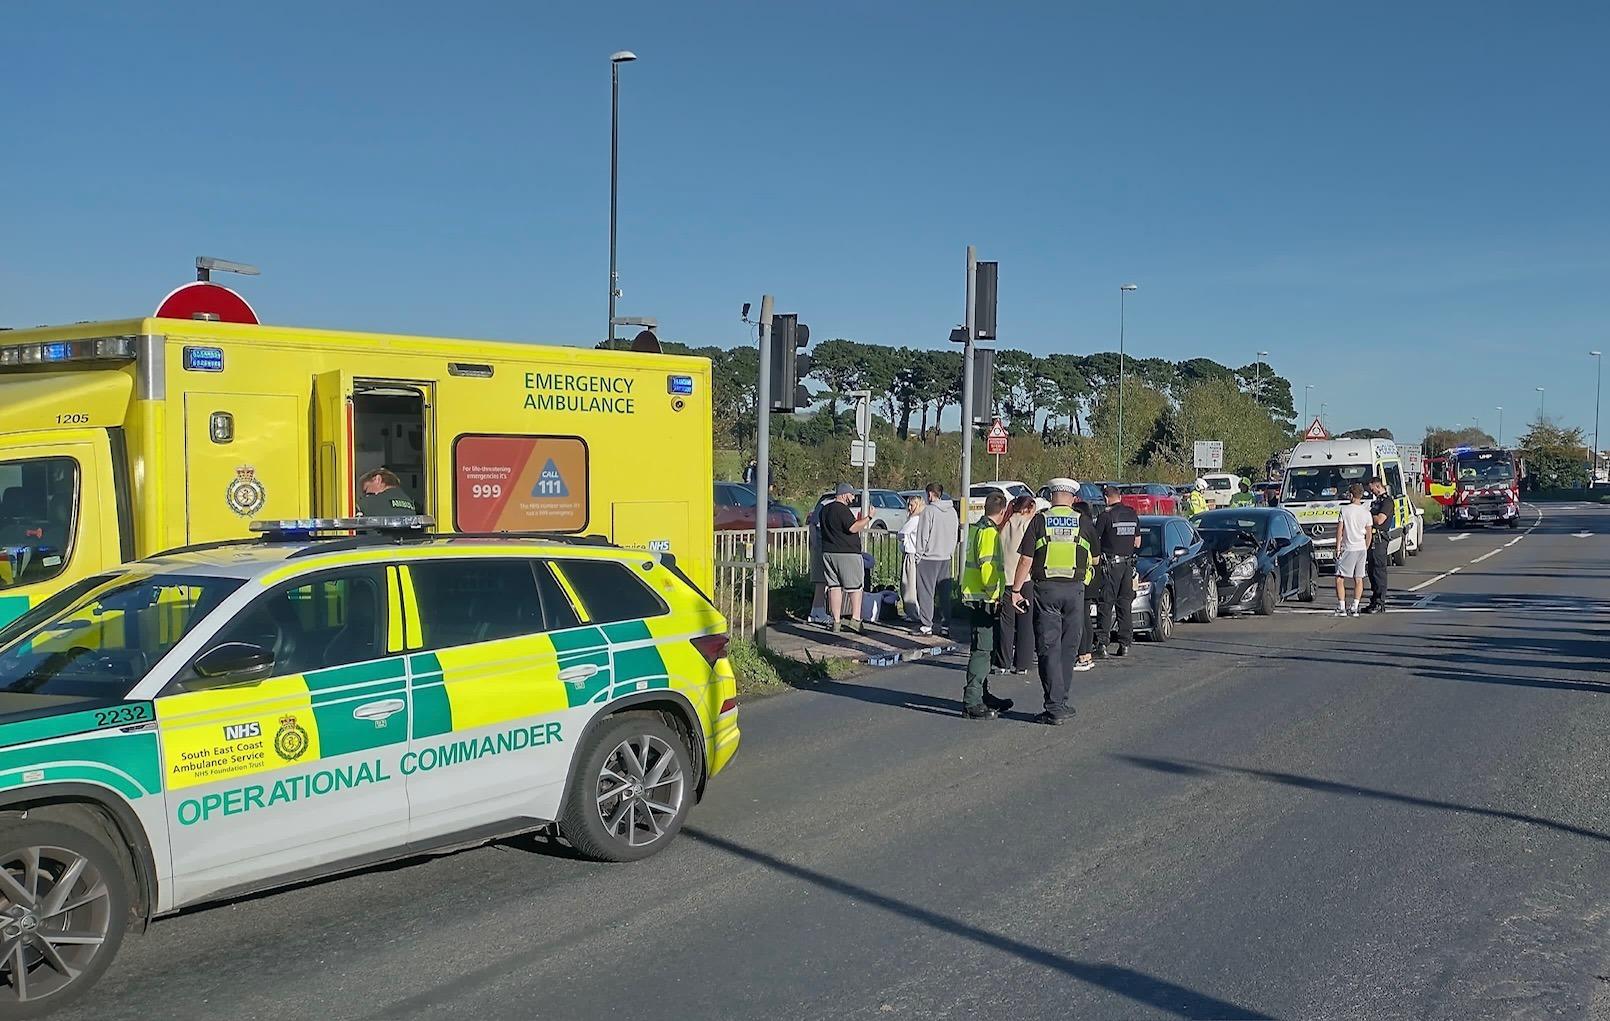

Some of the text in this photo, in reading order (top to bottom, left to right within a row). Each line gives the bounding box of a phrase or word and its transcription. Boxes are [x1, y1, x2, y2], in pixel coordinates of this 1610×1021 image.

[525, 372, 634, 394] EMERGENCY
[523, 394, 635, 414] AMBULANCE
[55, 413, 89, 425] 1205
[471, 465, 511, 473] life-threatening
[472, 484, 502, 498] 999
[538, 480, 561, 494] 111
[1047, 517, 1078, 527] POLICE
[649, 541, 669, 550] NHS
[94, 706, 148, 727] 2232
[225, 722, 261, 740] NHS
[181, 741, 263, 760] South East Coast
[173, 752, 265, 774] Ambulance Service
[194, 761, 265, 778] NHS Foundation Trust
[177, 722, 563, 826] OPERATIONAL COMMANDER
